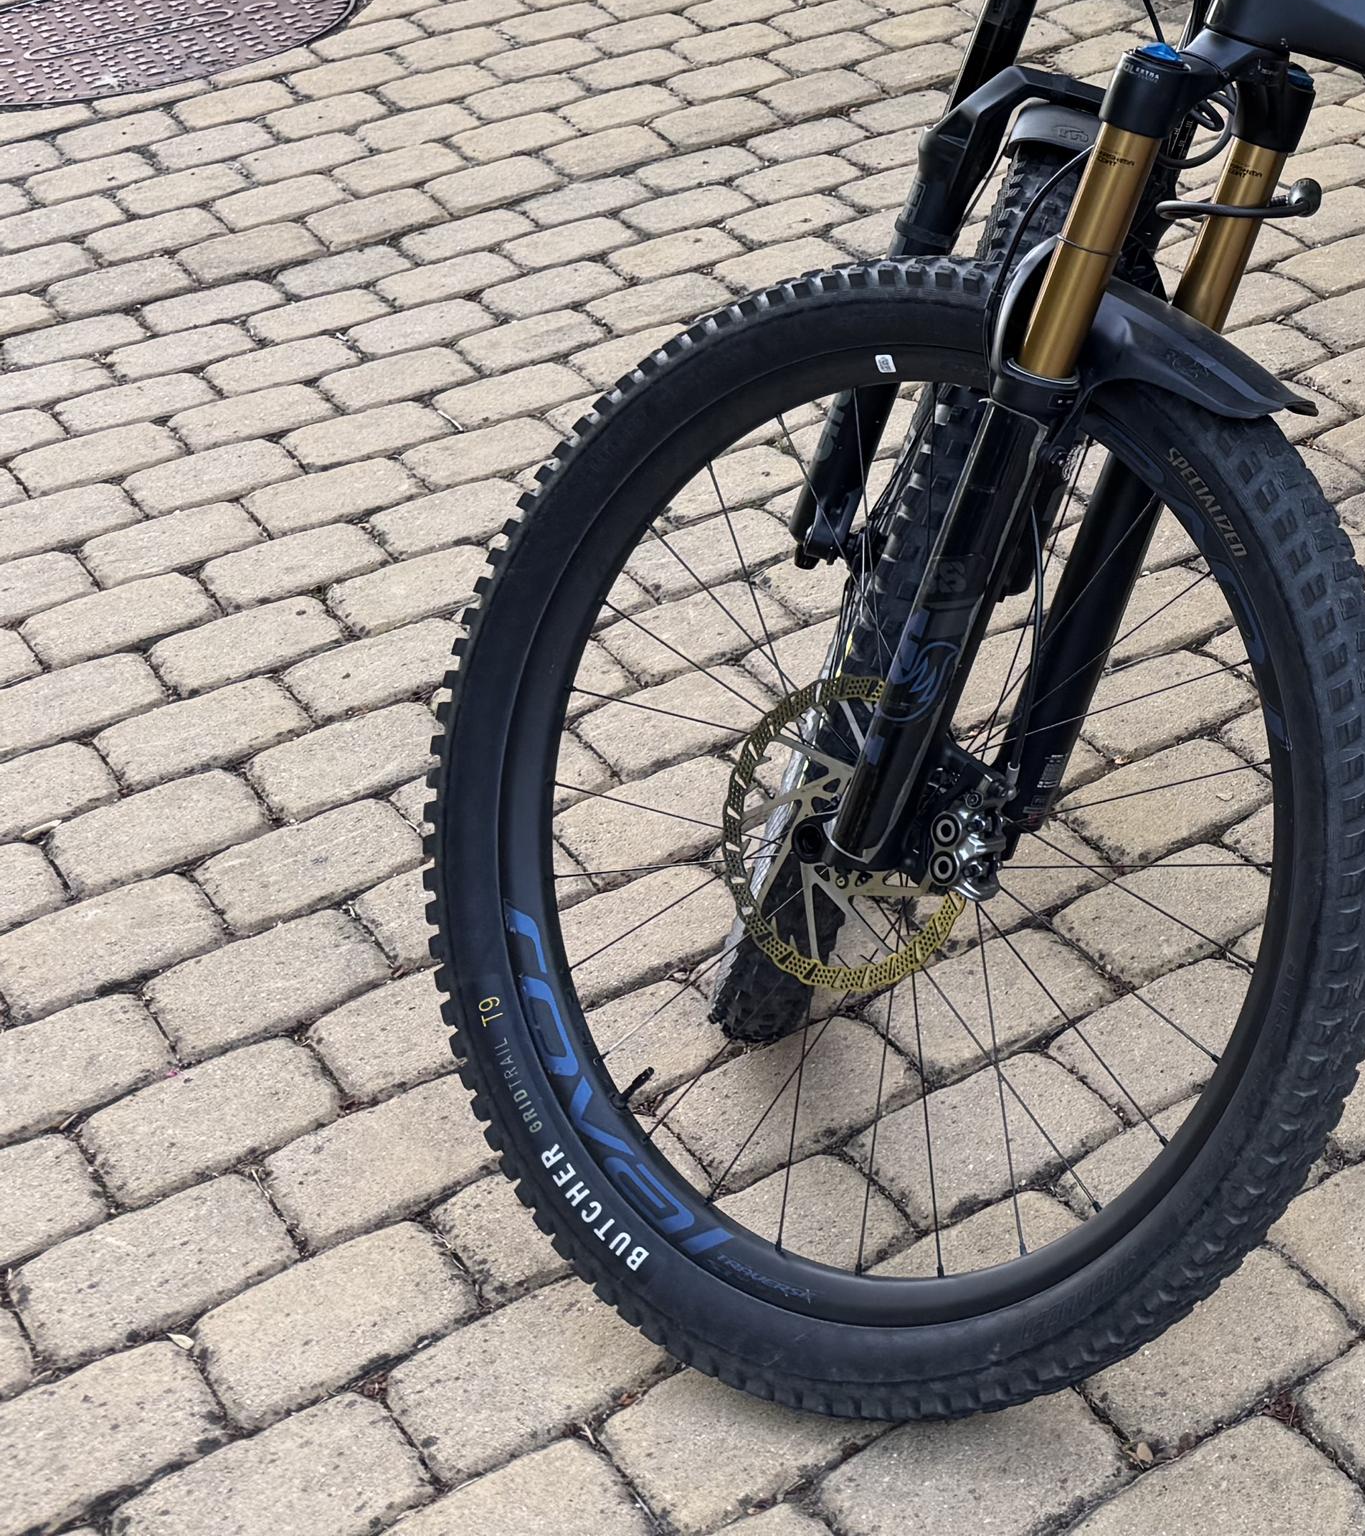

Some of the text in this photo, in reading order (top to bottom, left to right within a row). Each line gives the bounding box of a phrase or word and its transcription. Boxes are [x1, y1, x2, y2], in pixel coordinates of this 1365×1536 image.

[1165, 446, 1248, 559] SPECIALIZED
[481, 995, 502, 1029] T9
[540, 1143, 650, 1273] BUTCHER
